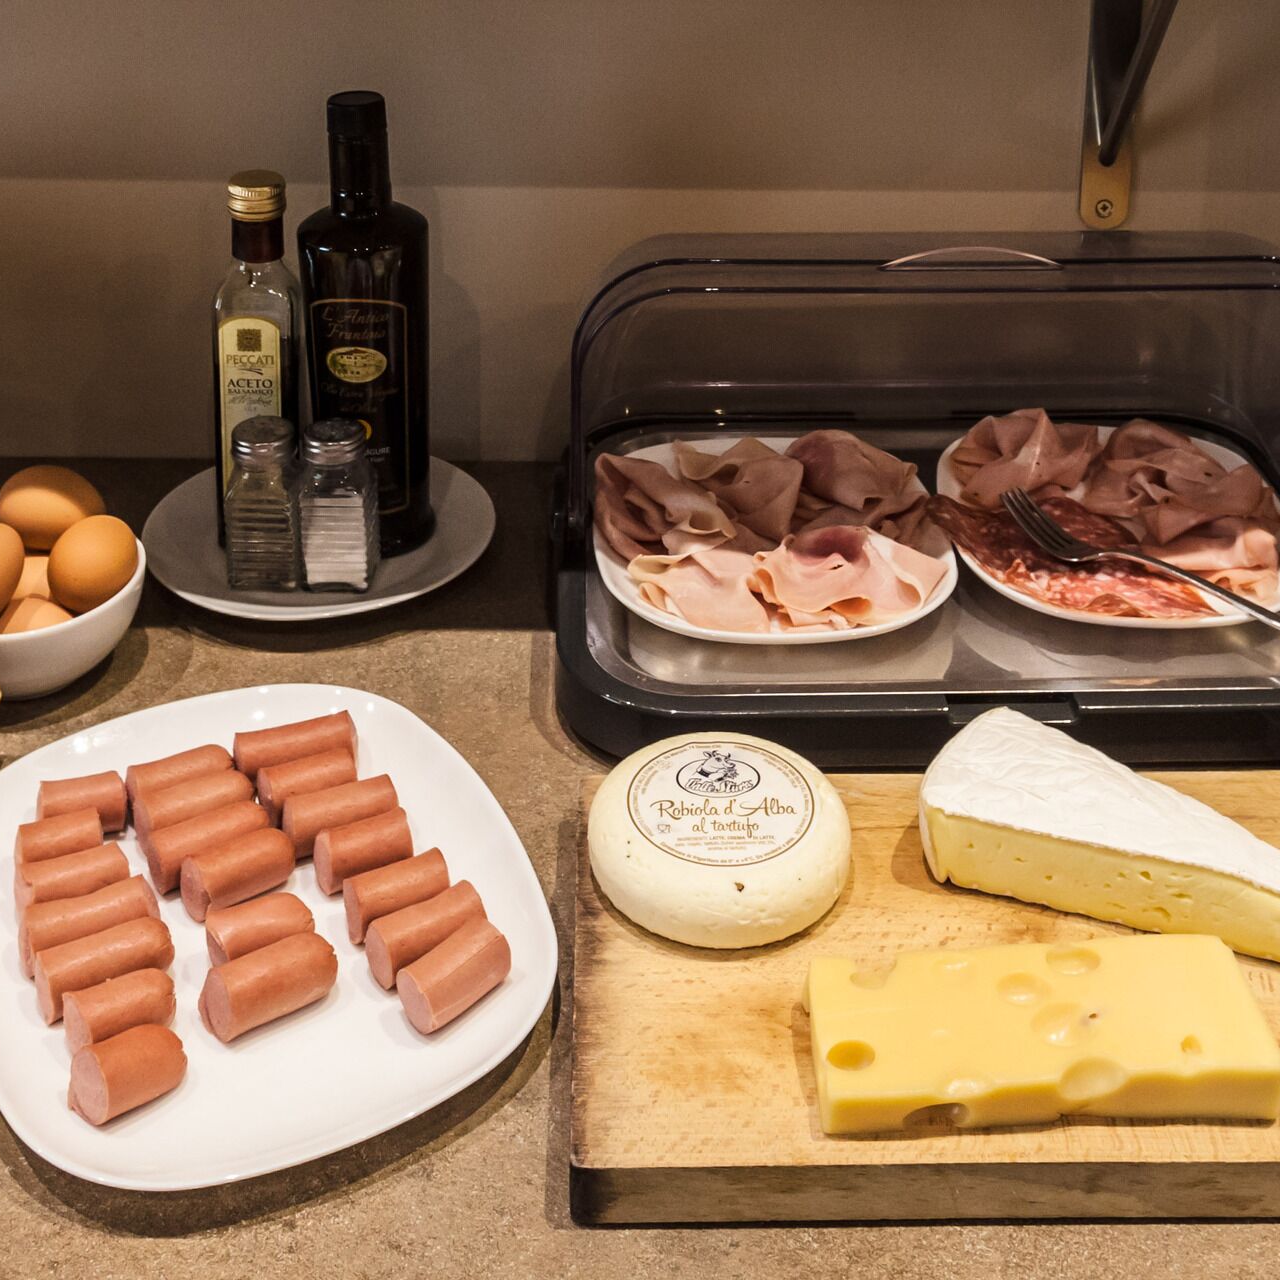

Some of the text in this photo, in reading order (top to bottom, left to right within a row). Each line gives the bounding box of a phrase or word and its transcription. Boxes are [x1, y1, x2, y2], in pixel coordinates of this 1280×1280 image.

[226, 354, 274, 366] PECCATI
[227, 378, 273, 389] ACETO
[227, 388, 273, 397] BALSAMICO
[650, 799, 720, 820] Robiola
[724, 797, 797, 817] d'Alba
[692, 817, 759, 838] al tartufo
